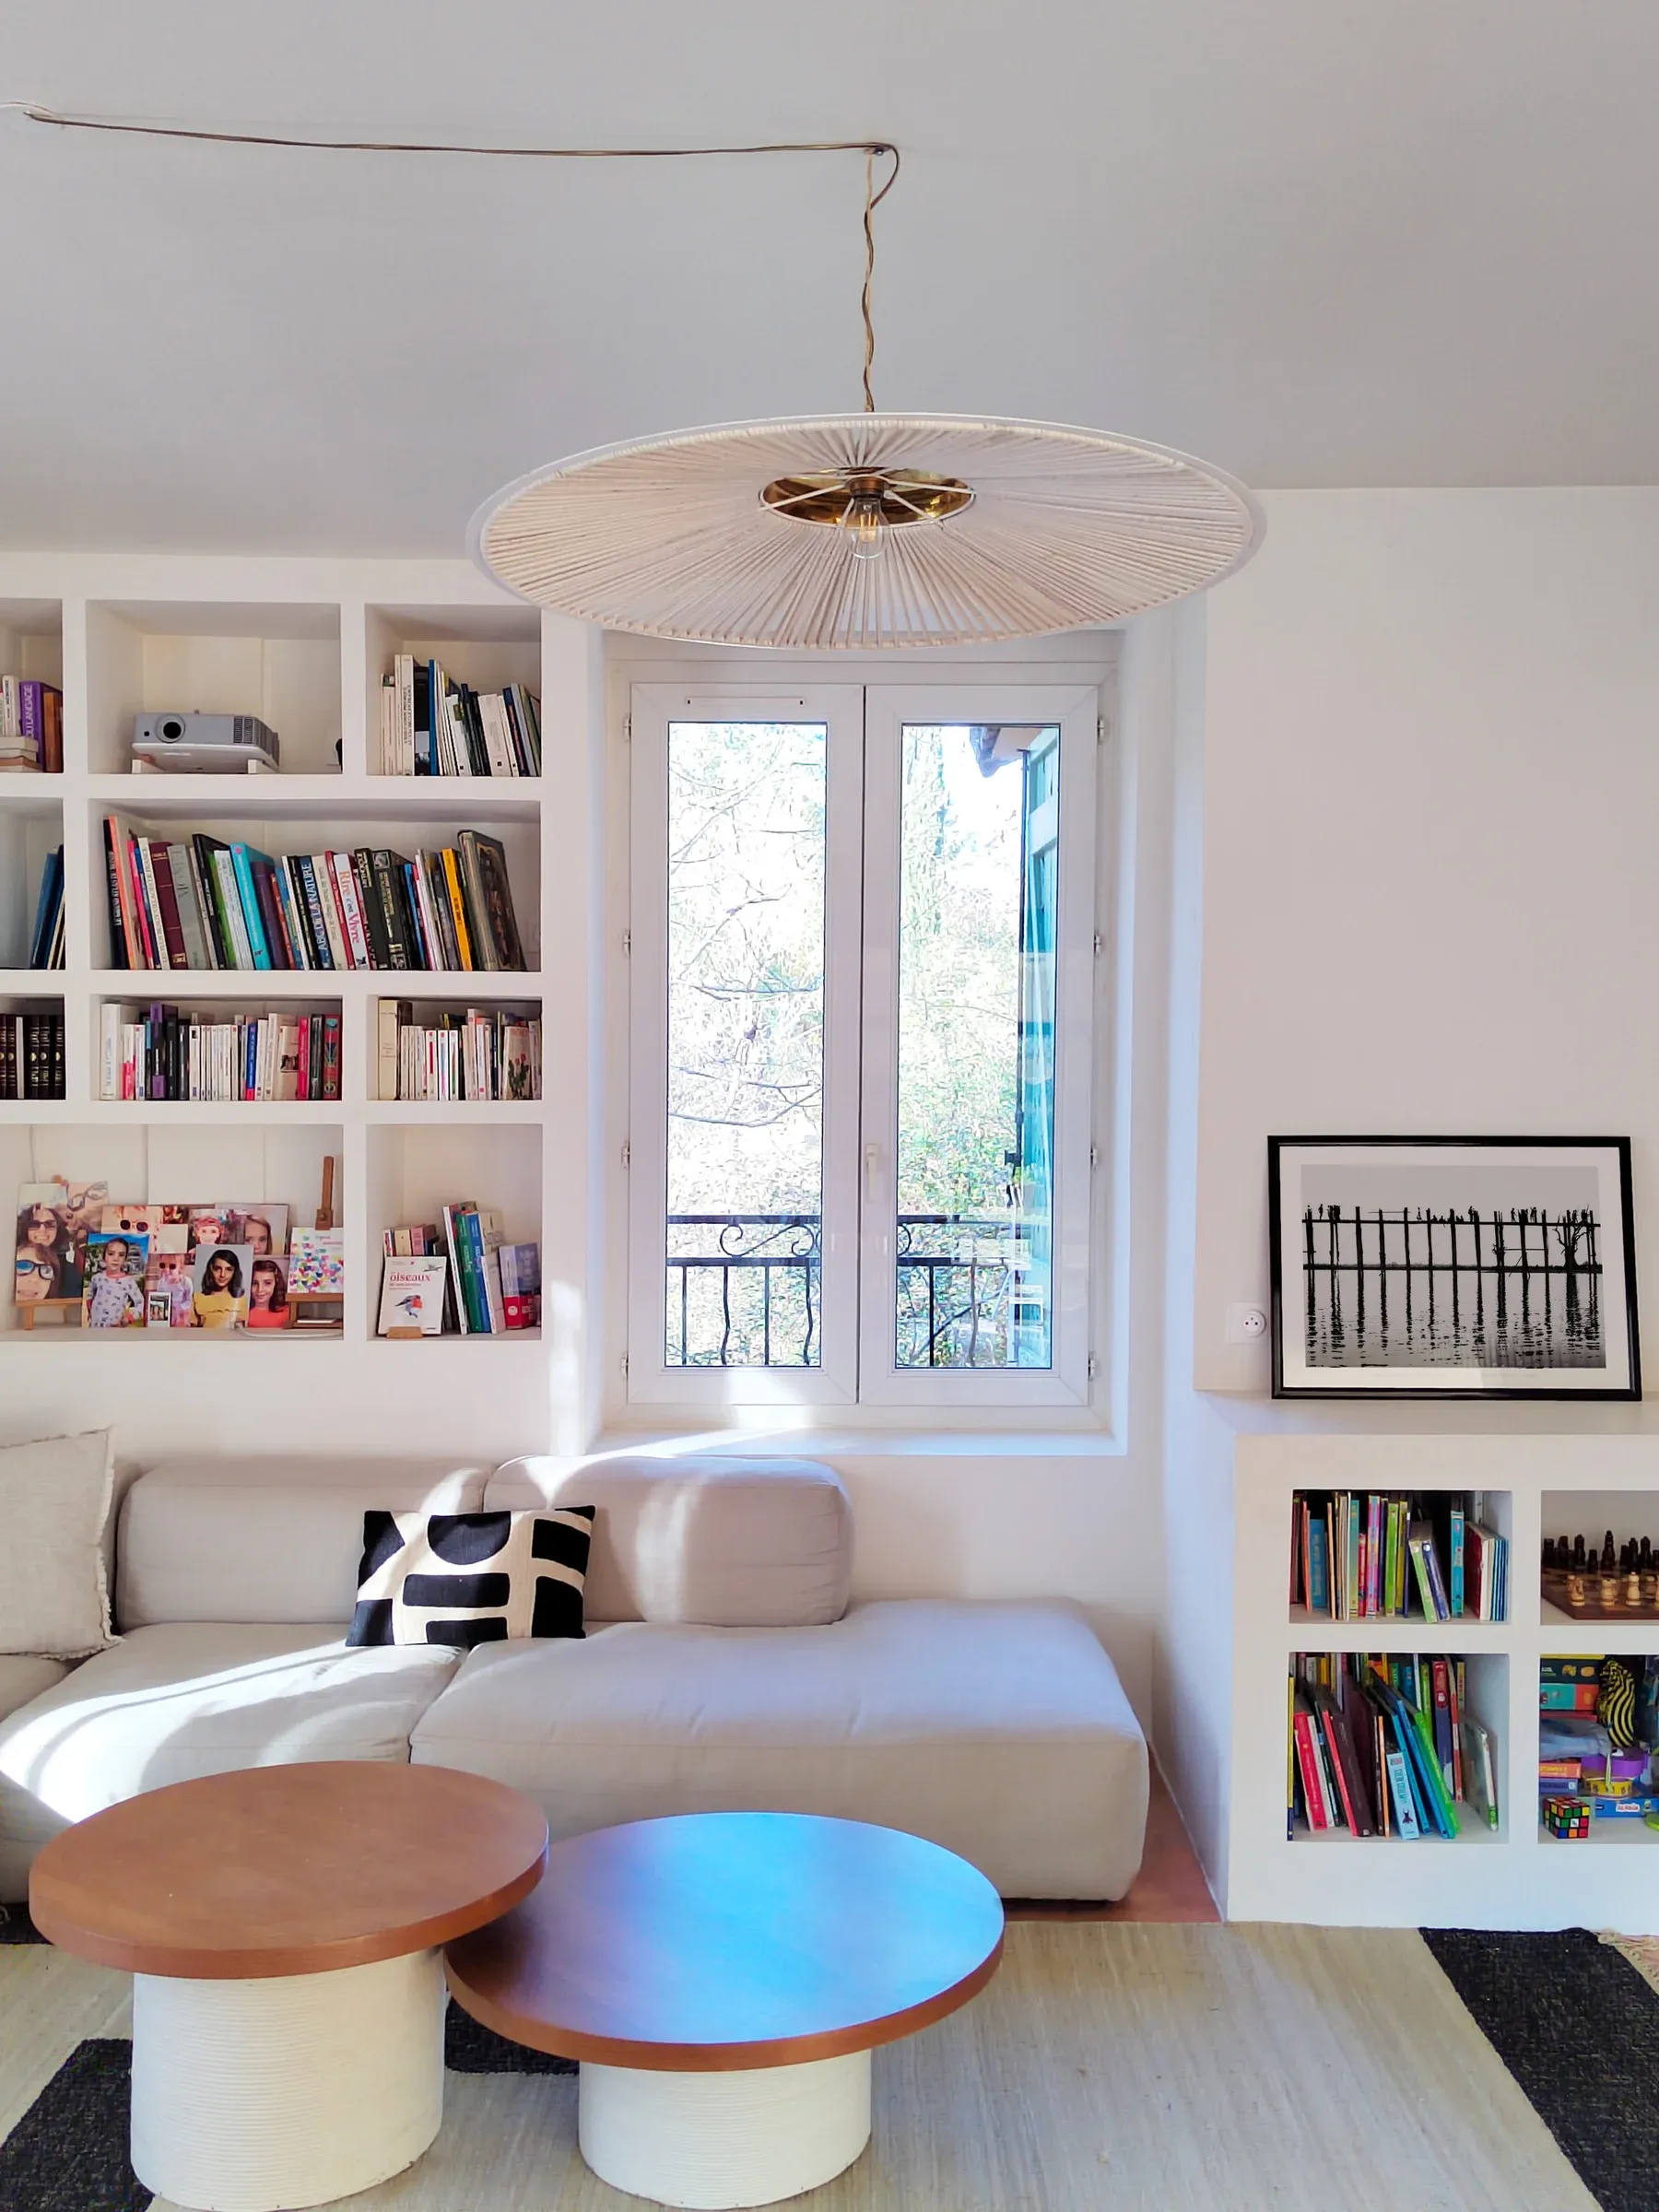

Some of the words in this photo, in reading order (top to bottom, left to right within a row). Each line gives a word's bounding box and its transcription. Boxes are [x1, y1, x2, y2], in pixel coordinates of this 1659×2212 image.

[24, 685, 33, 725] LANGAGE
[301, 863, 319, 901] NATURE
[310, 902, 323, 917] LA
[316, 931, 328, 950] ABC
[349, 912, 360, 944] Vivre
[390, 1273, 431, 1282] oiseaux
